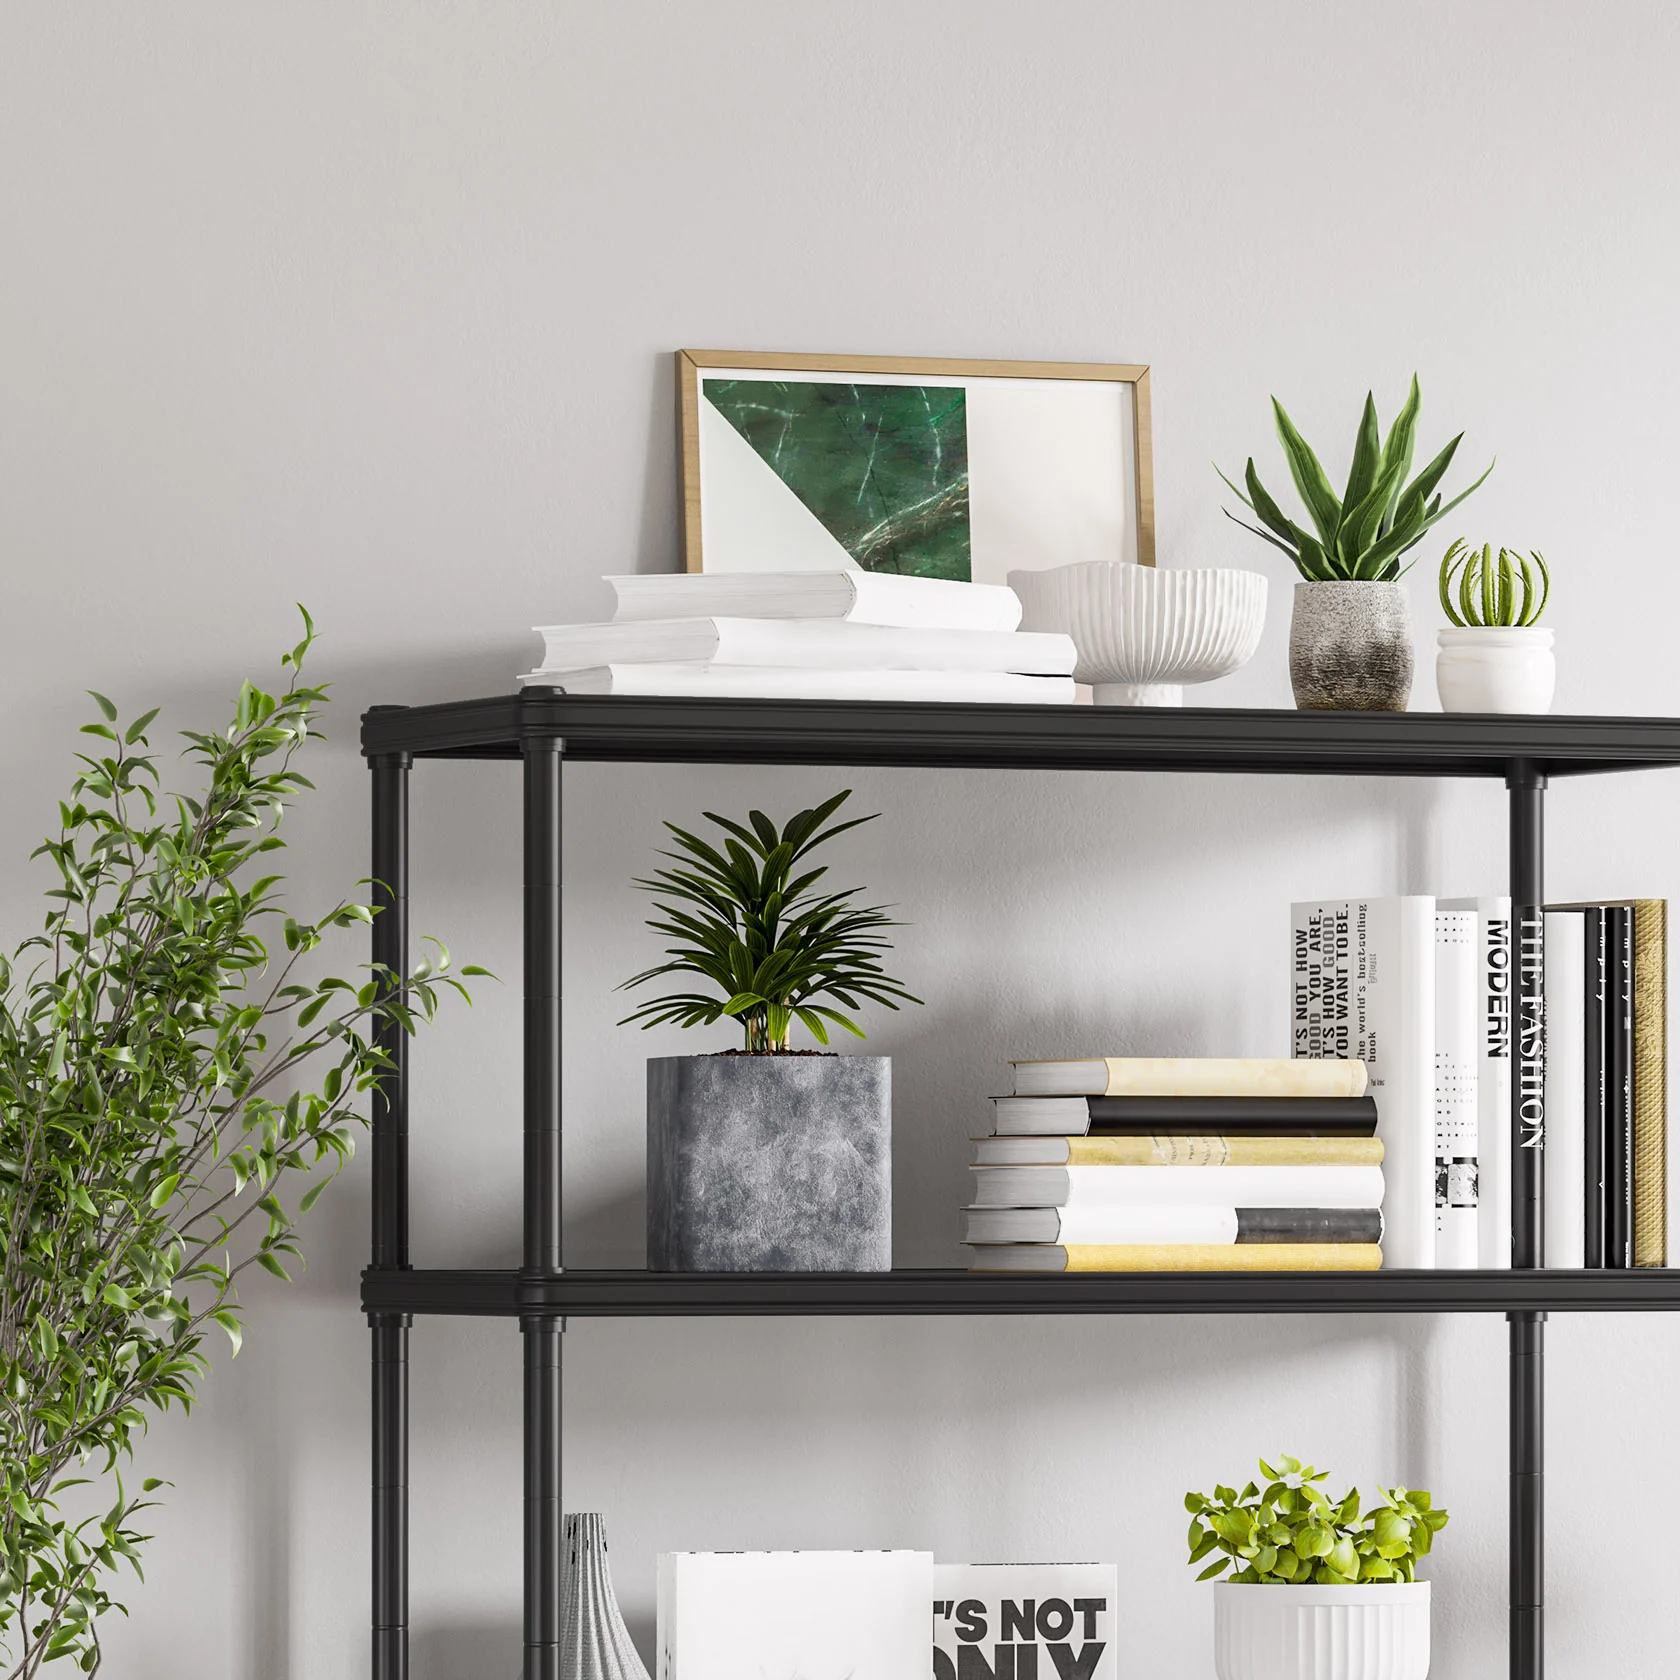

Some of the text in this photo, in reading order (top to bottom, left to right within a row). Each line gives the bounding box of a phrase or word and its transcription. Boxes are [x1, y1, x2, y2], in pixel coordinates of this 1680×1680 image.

[1308, 908, 1323, 953] ARE,
[1295, 929, 1308, 1059] T'S NOT HOW
[1308, 964, 1322, 1002] YOU
[1322, 916, 1335, 1058] T'S HOW GOOD
[1336, 966, 1348, 1021] WANT
[1486, 919, 1509, 1058] MODERN
[1356, 985, 1366, 1034] world's
[1519, 911, 1544, 1151] THE FASHION
[1367, 1031, 1377, 1063] book
[1000, 1597, 1107, 1641] NOT
